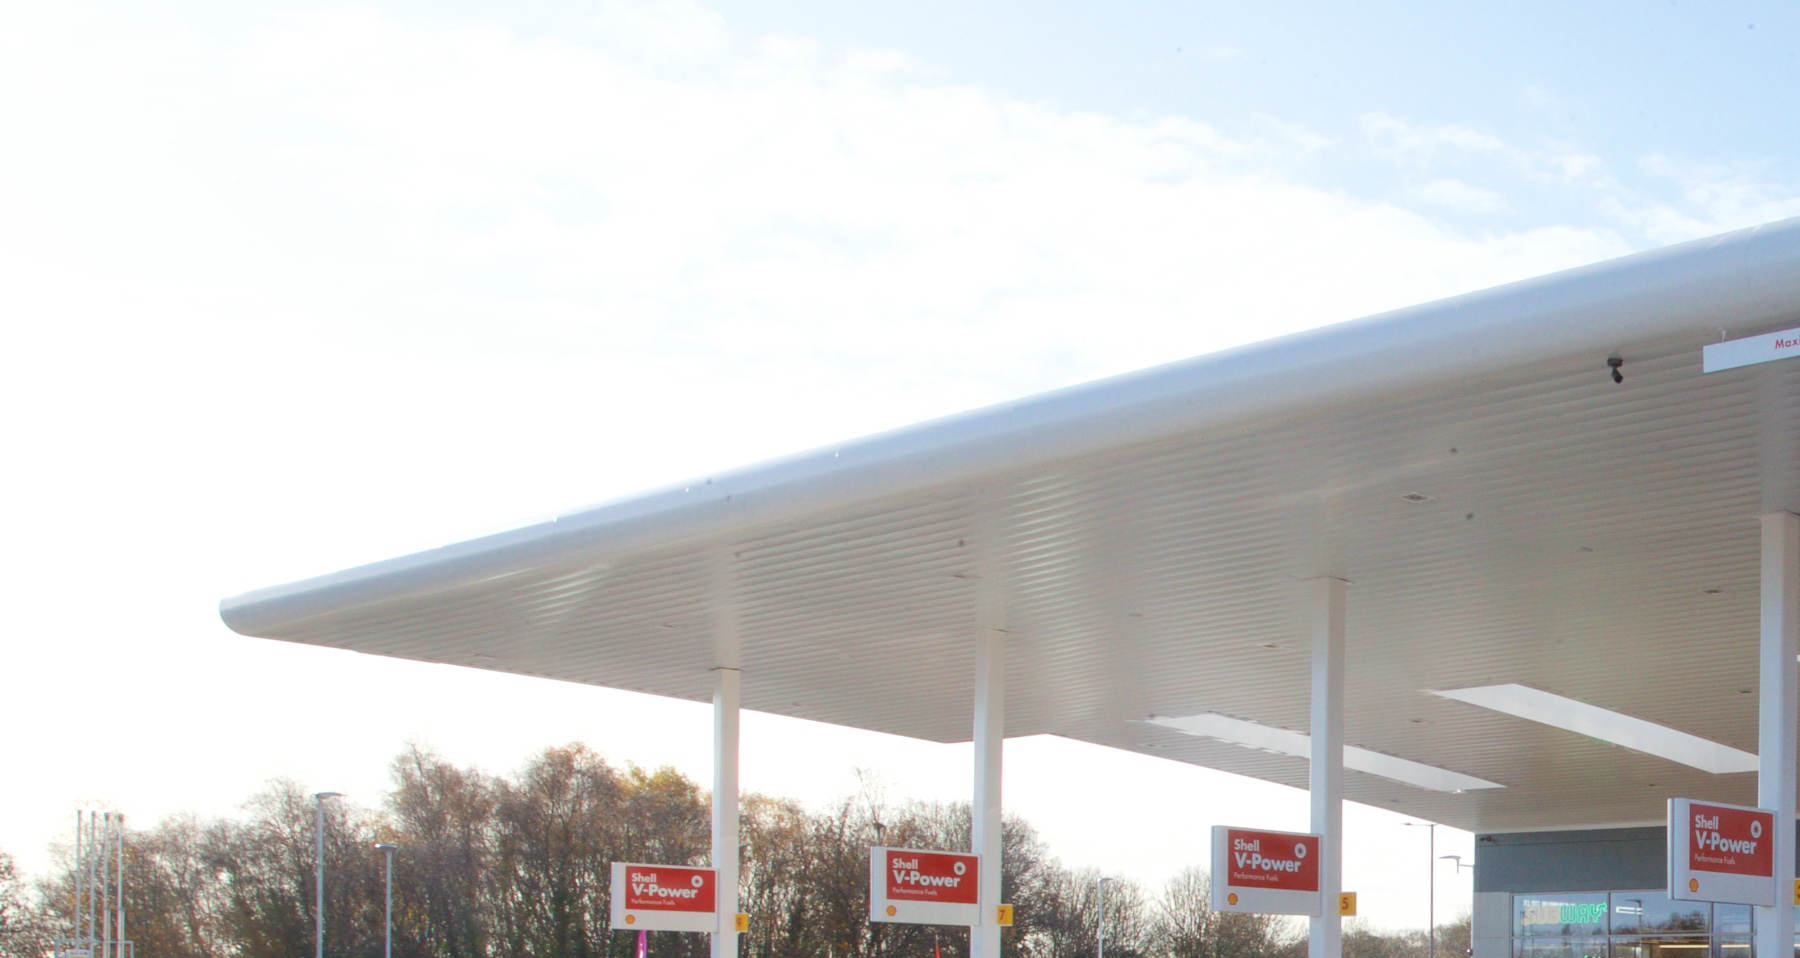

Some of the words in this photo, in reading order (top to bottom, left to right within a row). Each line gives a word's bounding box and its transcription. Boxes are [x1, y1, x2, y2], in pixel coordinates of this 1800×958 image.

[1695, 814, 1719, 830] Shell
[1234, 838, 1260, 852] Shell
[1695, 830, 1757, 855] V-Power
[892, 858, 918, 869] Shell
[1234, 852, 1302, 872] V-Power
[631, 872, 657, 883] Shell
[892, 869, 961, 887] V-Power
[632, 883, 698, 898] V-Power
[1341, 897, 1349, 910] 5
[999, 909, 1006, 920] 7
[1521, 902, 1608, 926] SUBWAY
